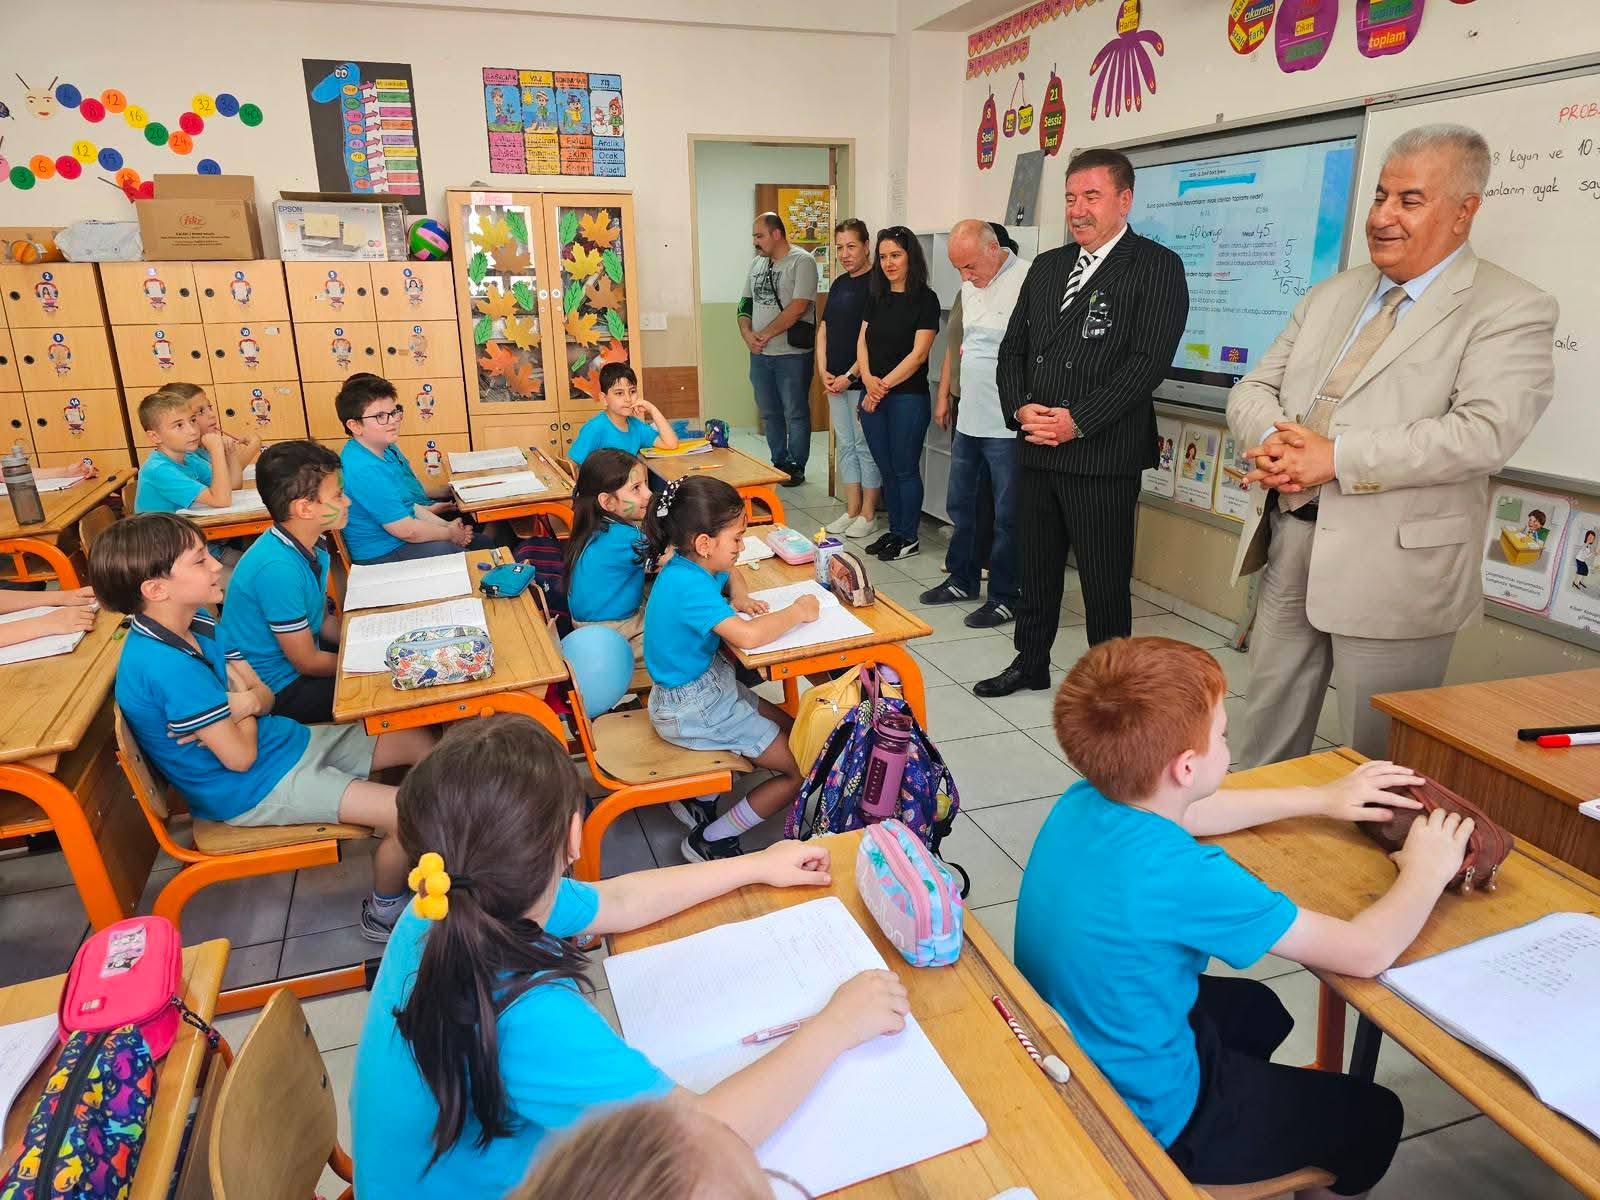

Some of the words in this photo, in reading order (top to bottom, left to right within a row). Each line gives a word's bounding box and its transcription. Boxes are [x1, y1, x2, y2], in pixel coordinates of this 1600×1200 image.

[1368, 30, 1405, 49] toplam
[107, 94, 119, 106] 12
[1049, 88, 1058, 101] 21
[198, 99, 212, 111] 32
[130, 112, 143, 122] 16
[1044, 113, 1062, 128] Sessiz
[150, 128, 165, 139] 20
[173, 136, 187, 147] 24
[1044, 134, 1058, 148] harf
[76, 144, 90, 157] 12
[599, 152, 618, 160] Ocak
[1493, 151, 1500, 165] 8
[1510, 149, 1539, 169] koyun
[1549, 149, 1564, 160] ve
[1578, 138, 1593, 156] 10
[38, 160, 46, 173] 6
[1532, 176, 1559, 202] ayak
[1256, 222, 1274, 239] 45
[1285, 238, 1297, 256] 5
[1281, 259, 1292, 274] 3
[1279, 278, 1293, 295] 15
[1554, 334, 1578, 352] aile
